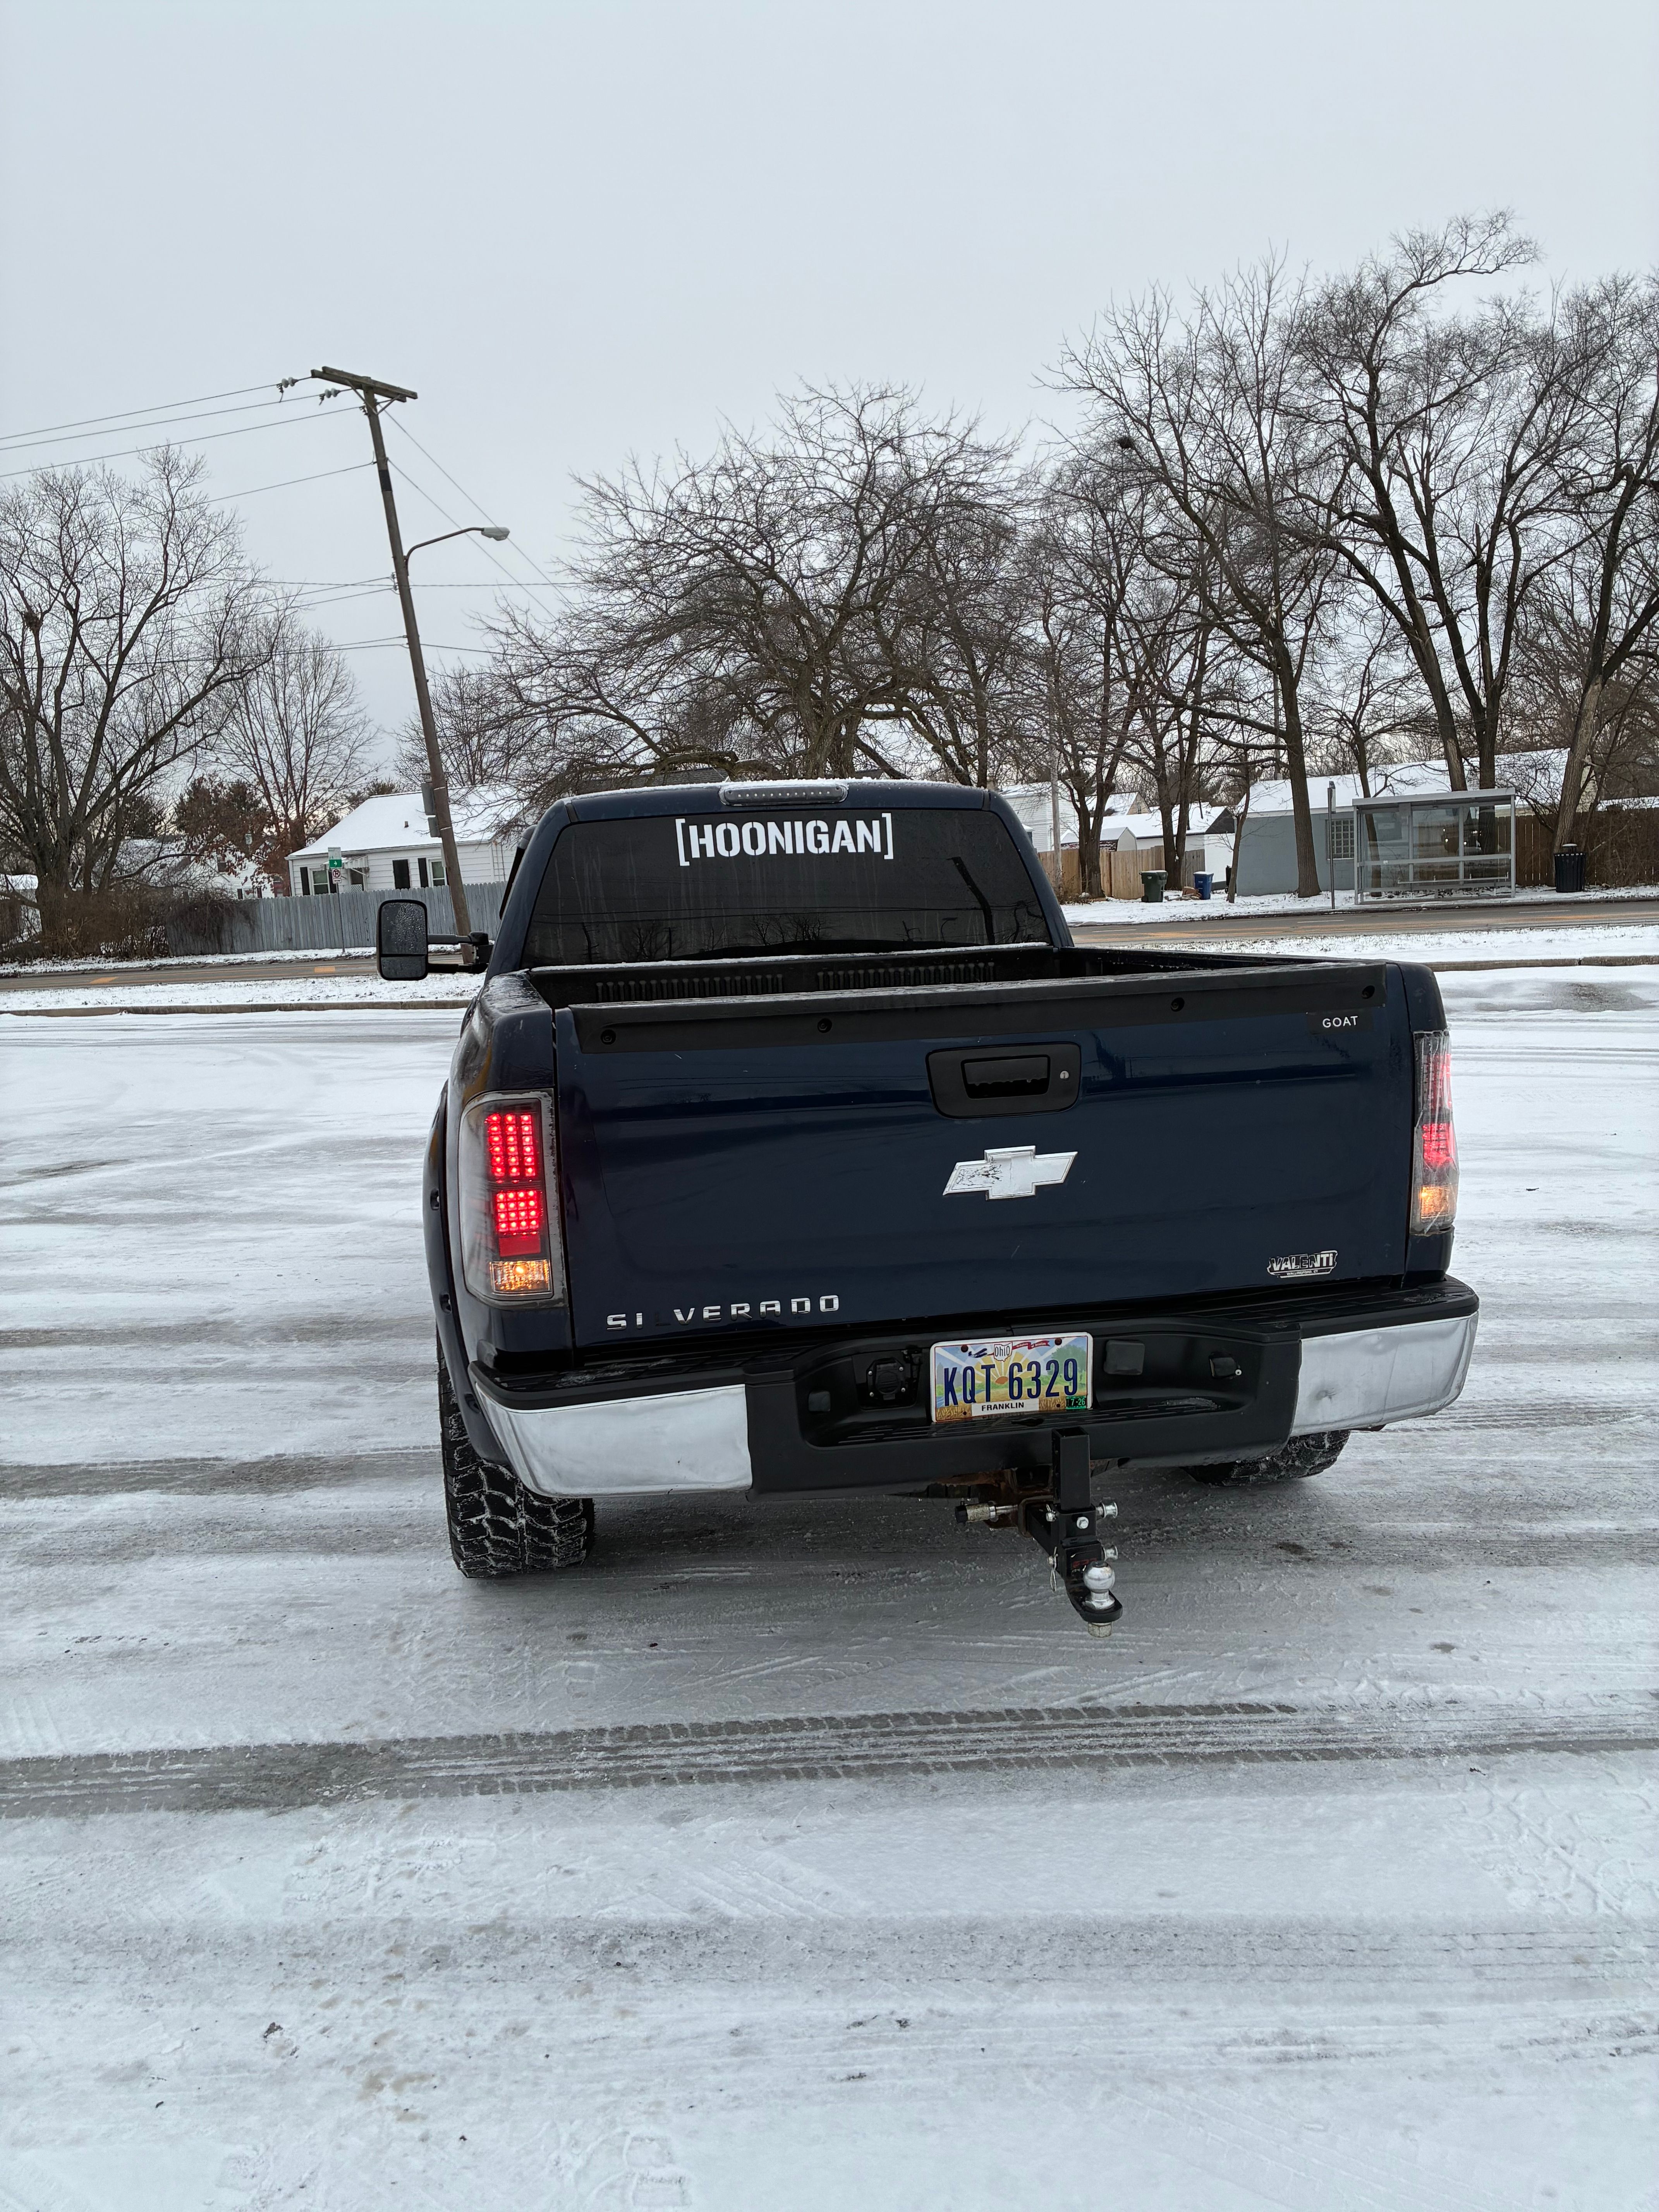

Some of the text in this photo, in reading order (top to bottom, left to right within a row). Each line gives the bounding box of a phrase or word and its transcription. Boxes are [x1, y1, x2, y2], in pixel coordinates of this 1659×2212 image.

[1322, 1015, 1358, 1028] GOAT
[1270, 1253, 1333, 1271] VALENTI
[606, 1295, 839, 1331] SIVERADO
[944, 1358, 1078, 1407] KQT 6329
[981, 1401, 1024, 1412] FRANKLIN
